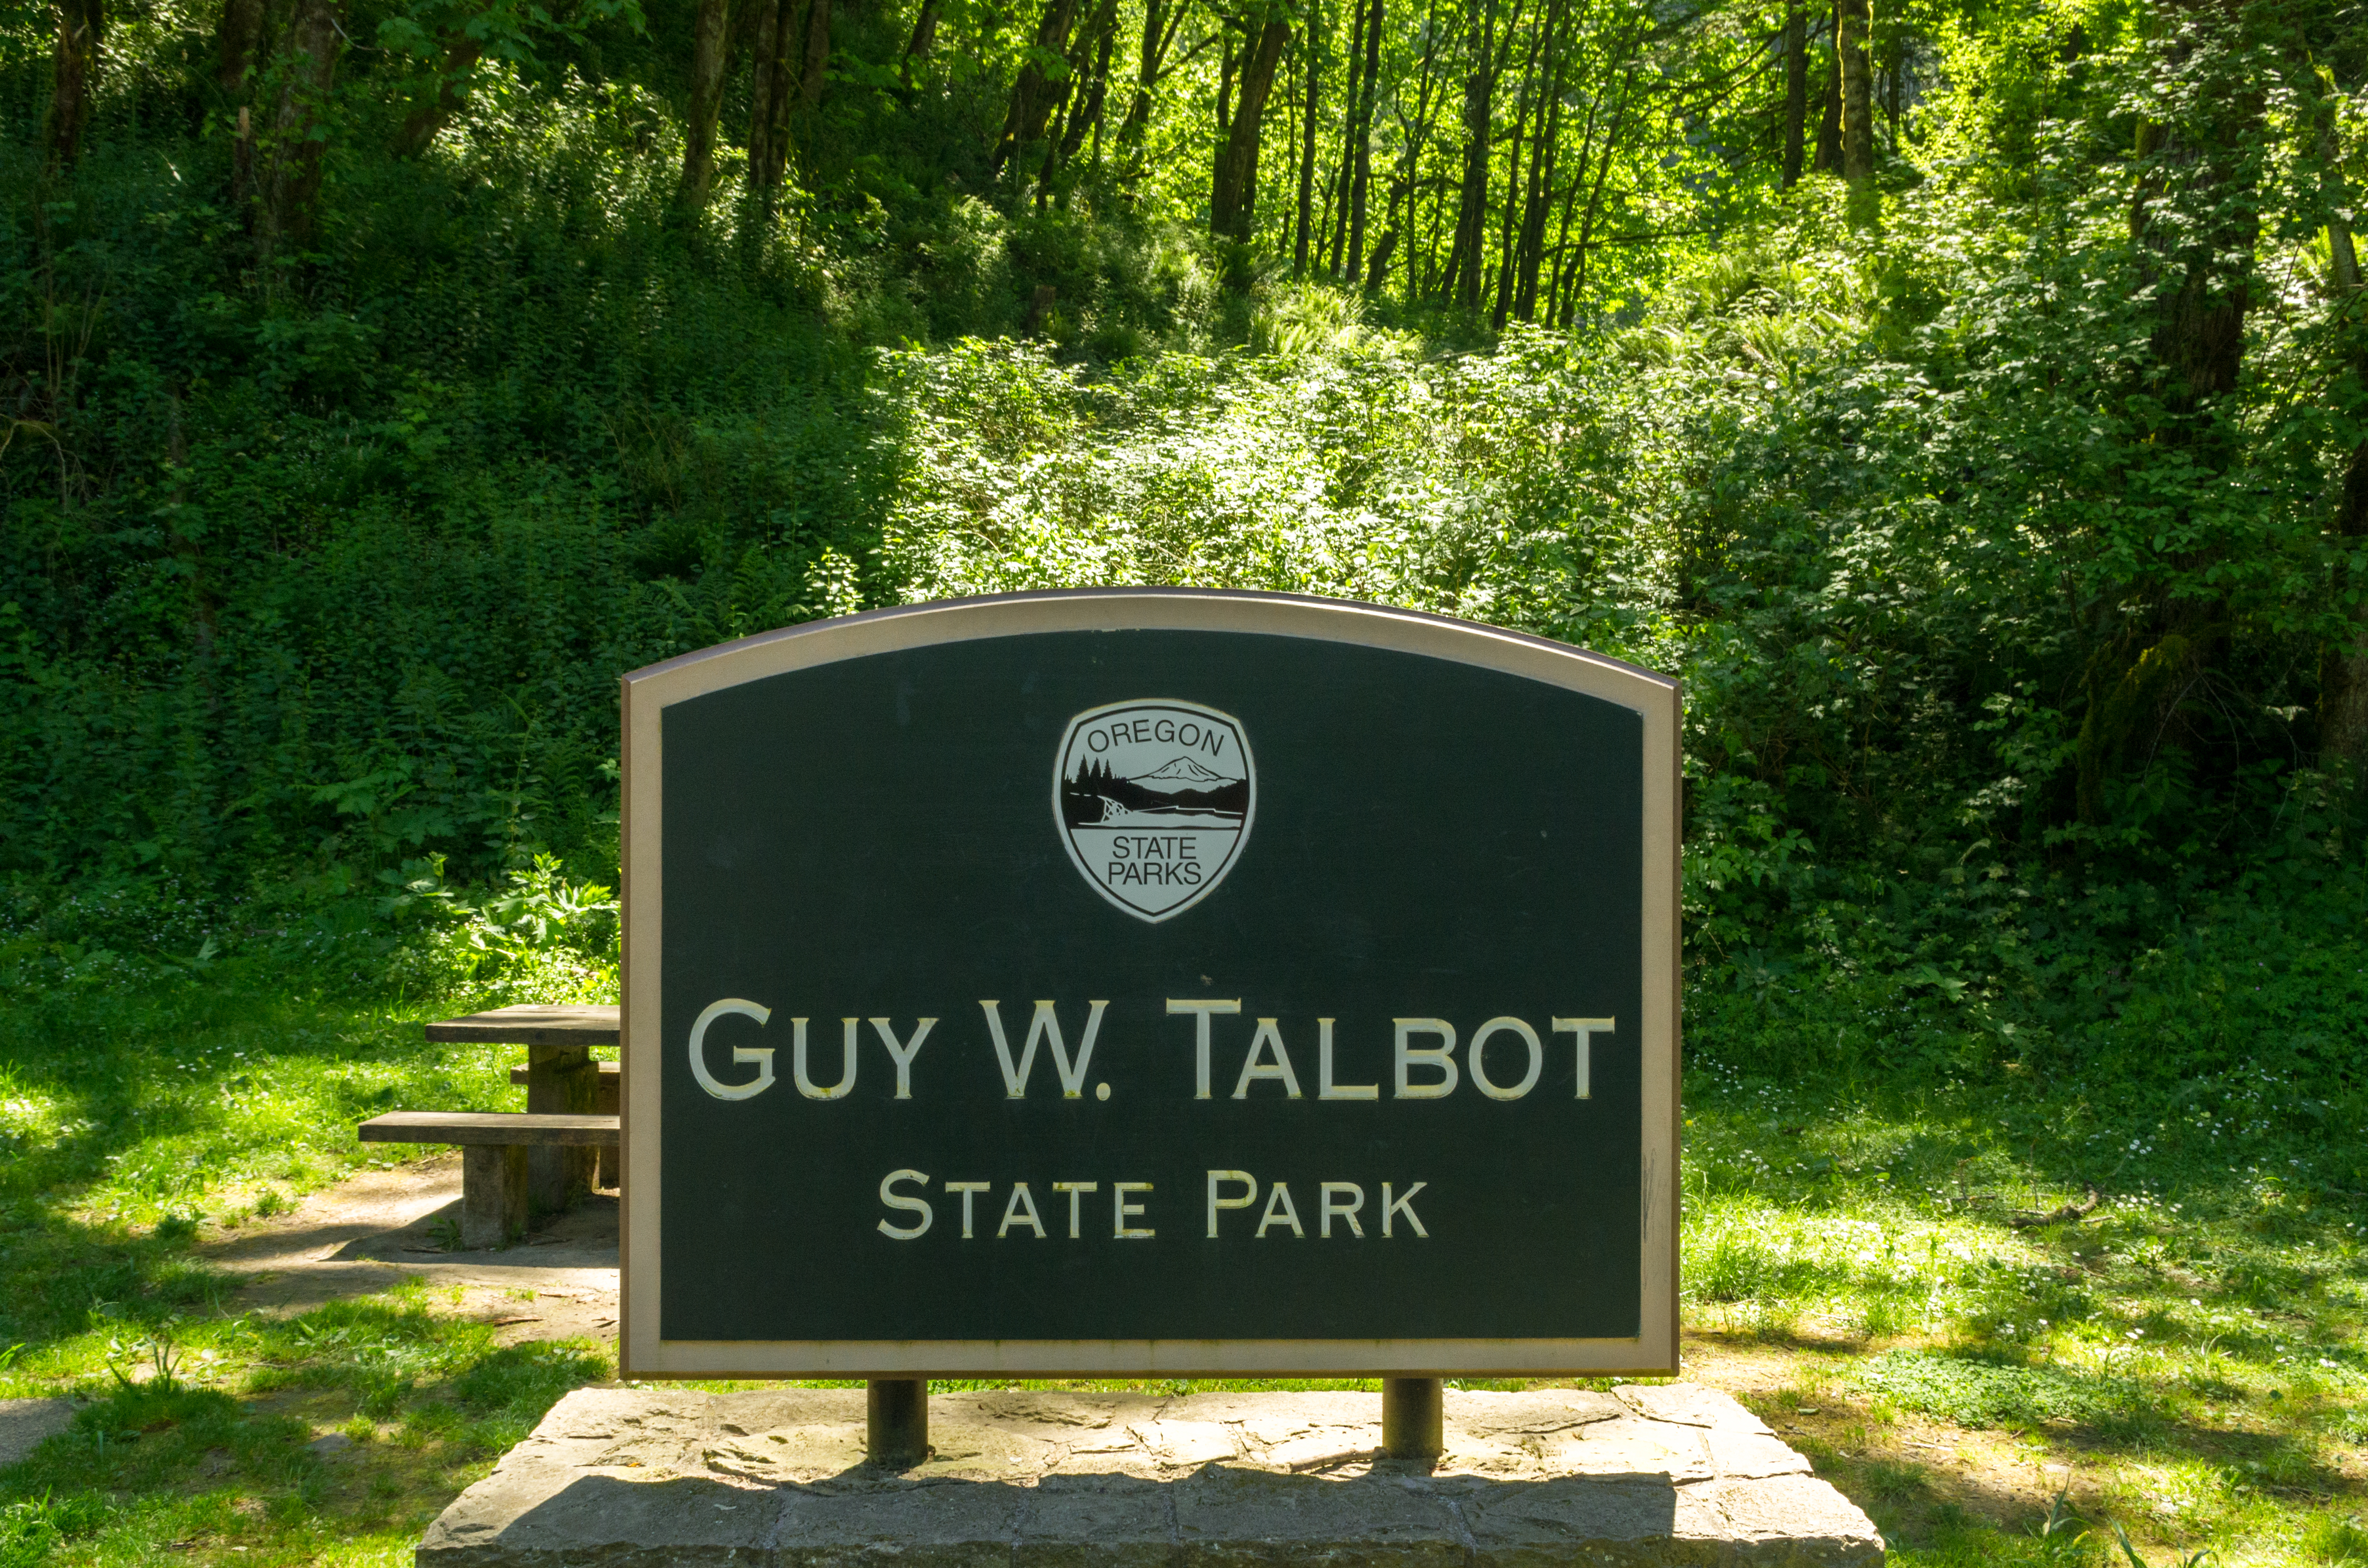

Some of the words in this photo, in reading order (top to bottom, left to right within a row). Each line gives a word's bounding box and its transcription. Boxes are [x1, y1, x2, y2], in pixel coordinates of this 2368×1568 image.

[1087, 719, 1224, 757] OREGON
[1112, 836, 1196, 859] STATE
[1108, 862, 1201, 885] PARKS
[689, 998, 938, 1101] GUY
[978, 1000, 1111, 1101] W.
[1166, 997, 1615, 1101] TALBOT
[877, 1169, 1155, 1240] STATE
[1207, 1170, 1429, 1238] PARK
